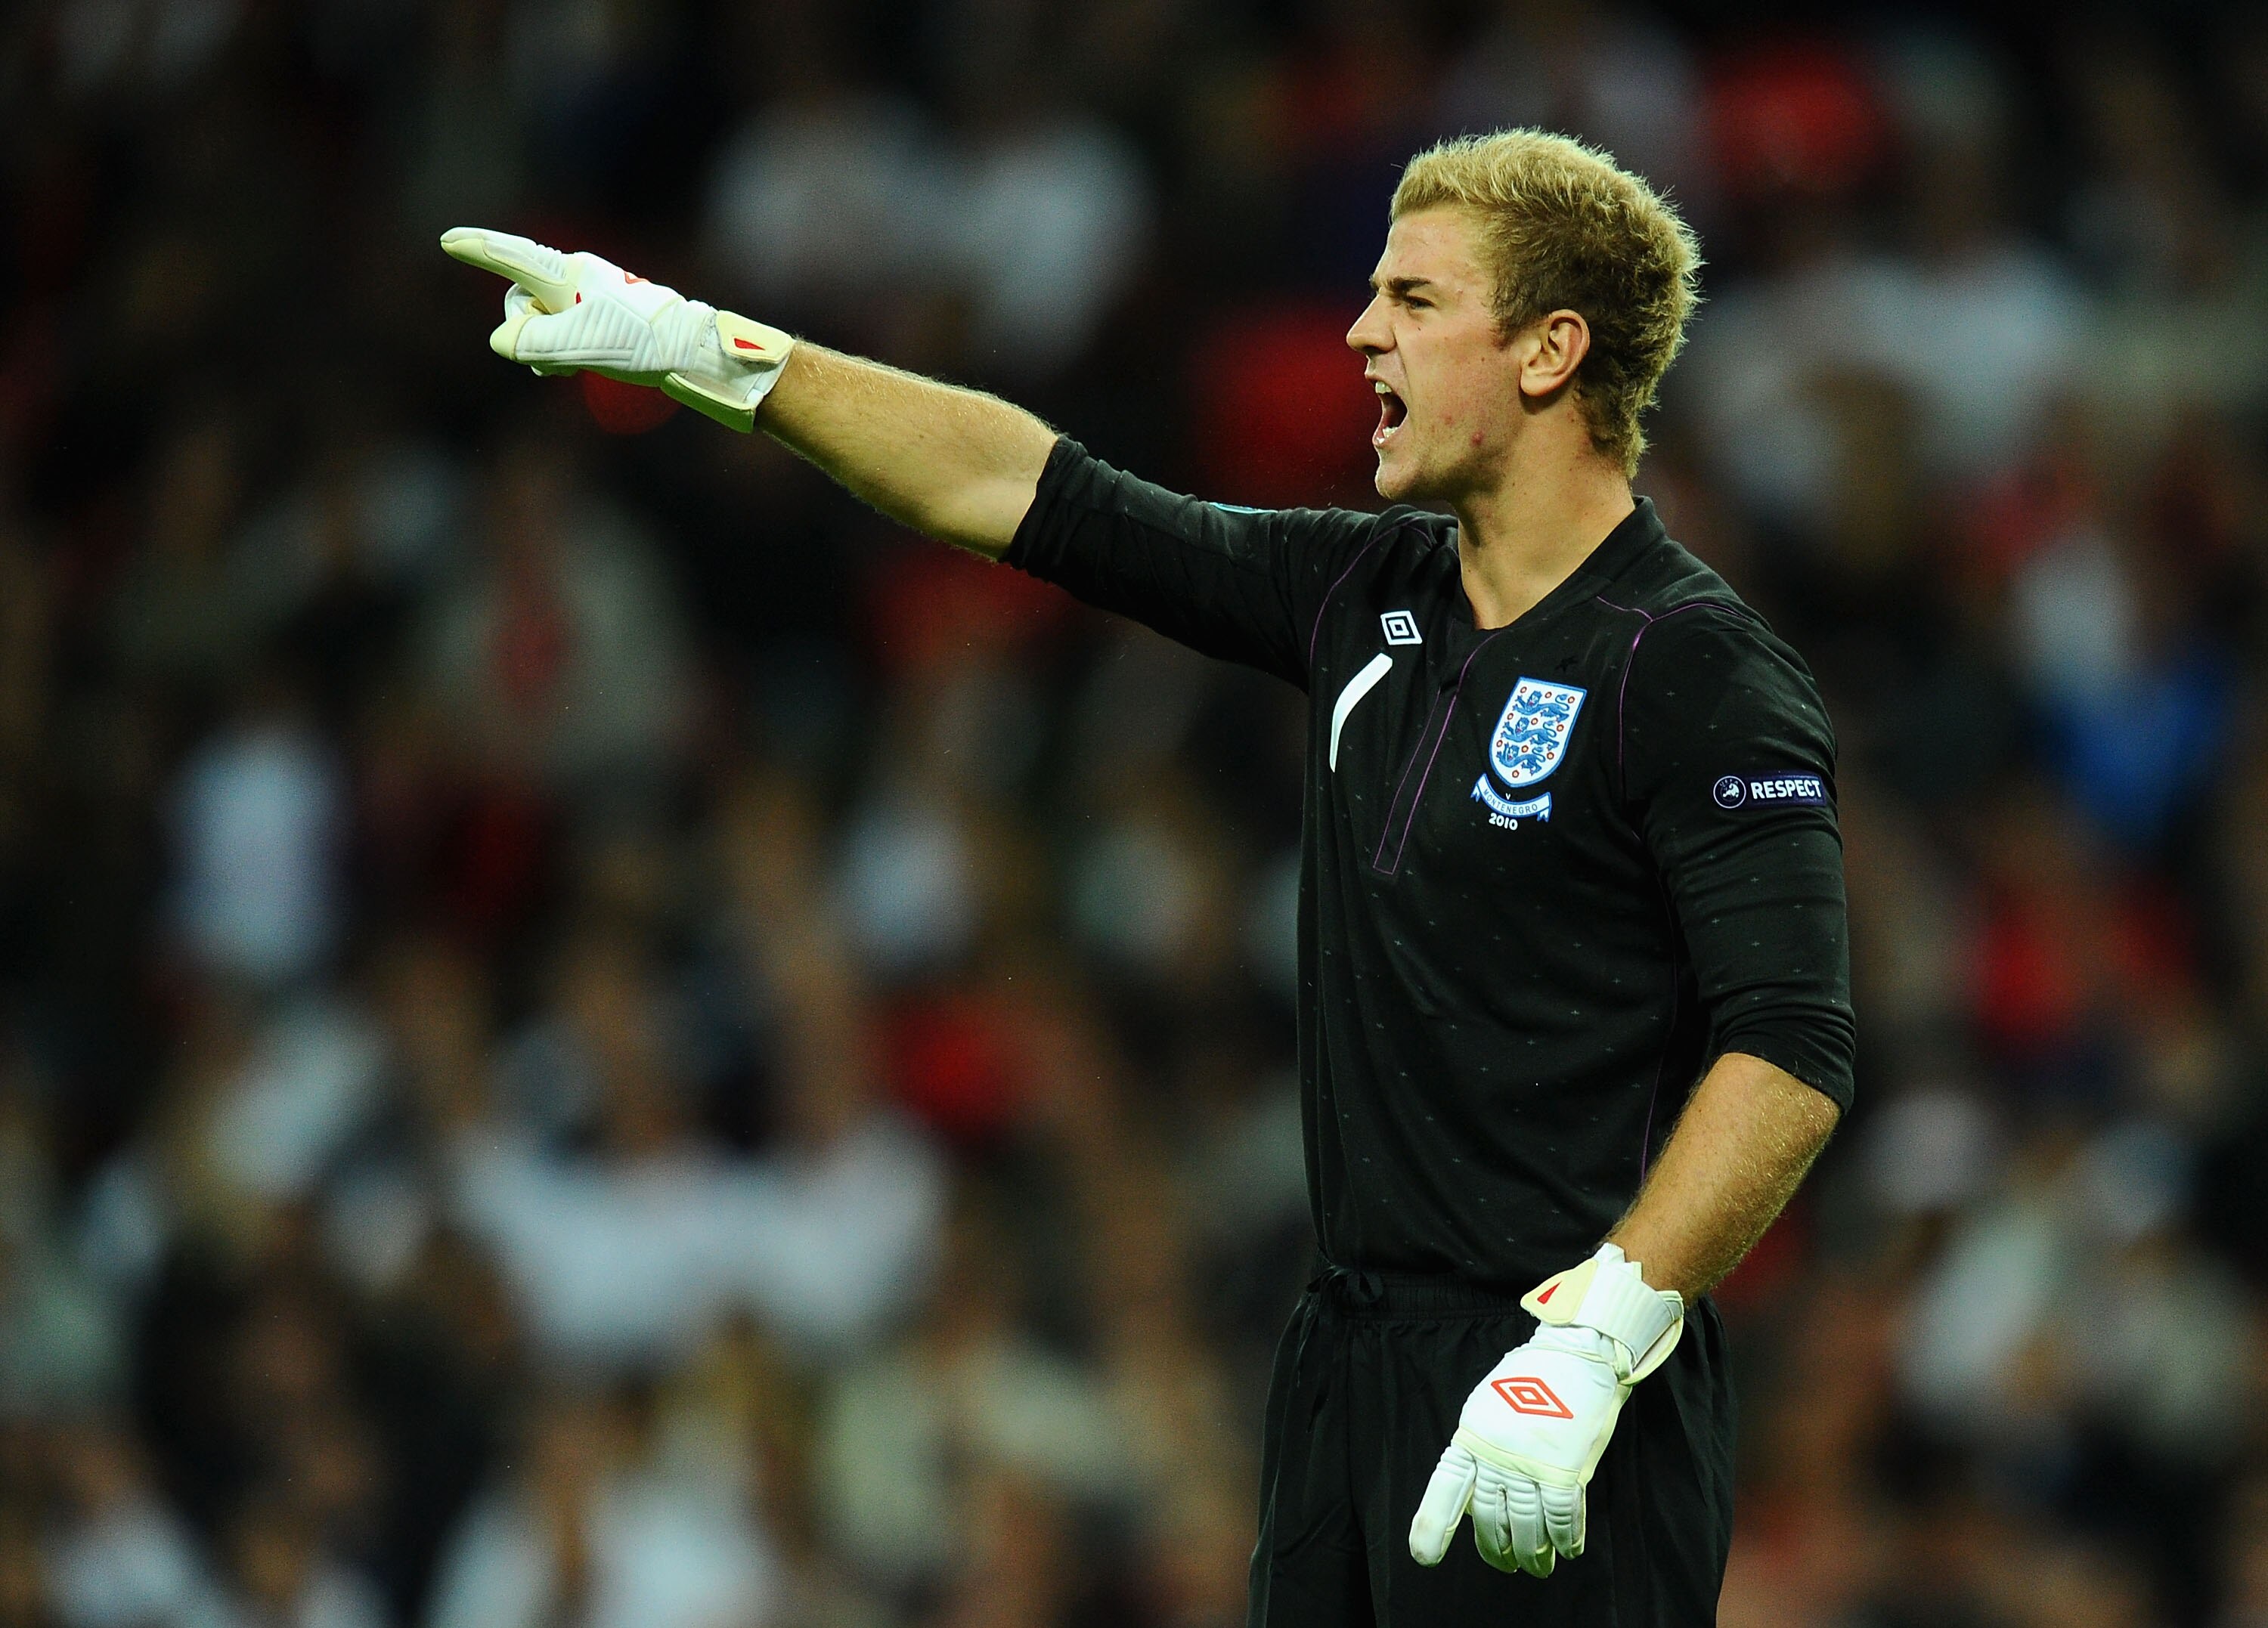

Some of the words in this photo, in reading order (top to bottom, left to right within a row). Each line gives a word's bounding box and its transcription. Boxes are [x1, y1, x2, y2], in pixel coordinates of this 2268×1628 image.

[1330, 652, 1393, 772] 1
[1483, 788, 1538, 815] MONTENEGRO
[1750, 779, 1822, 800] RESPECT
[1489, 812, 1518, 831] 2010
